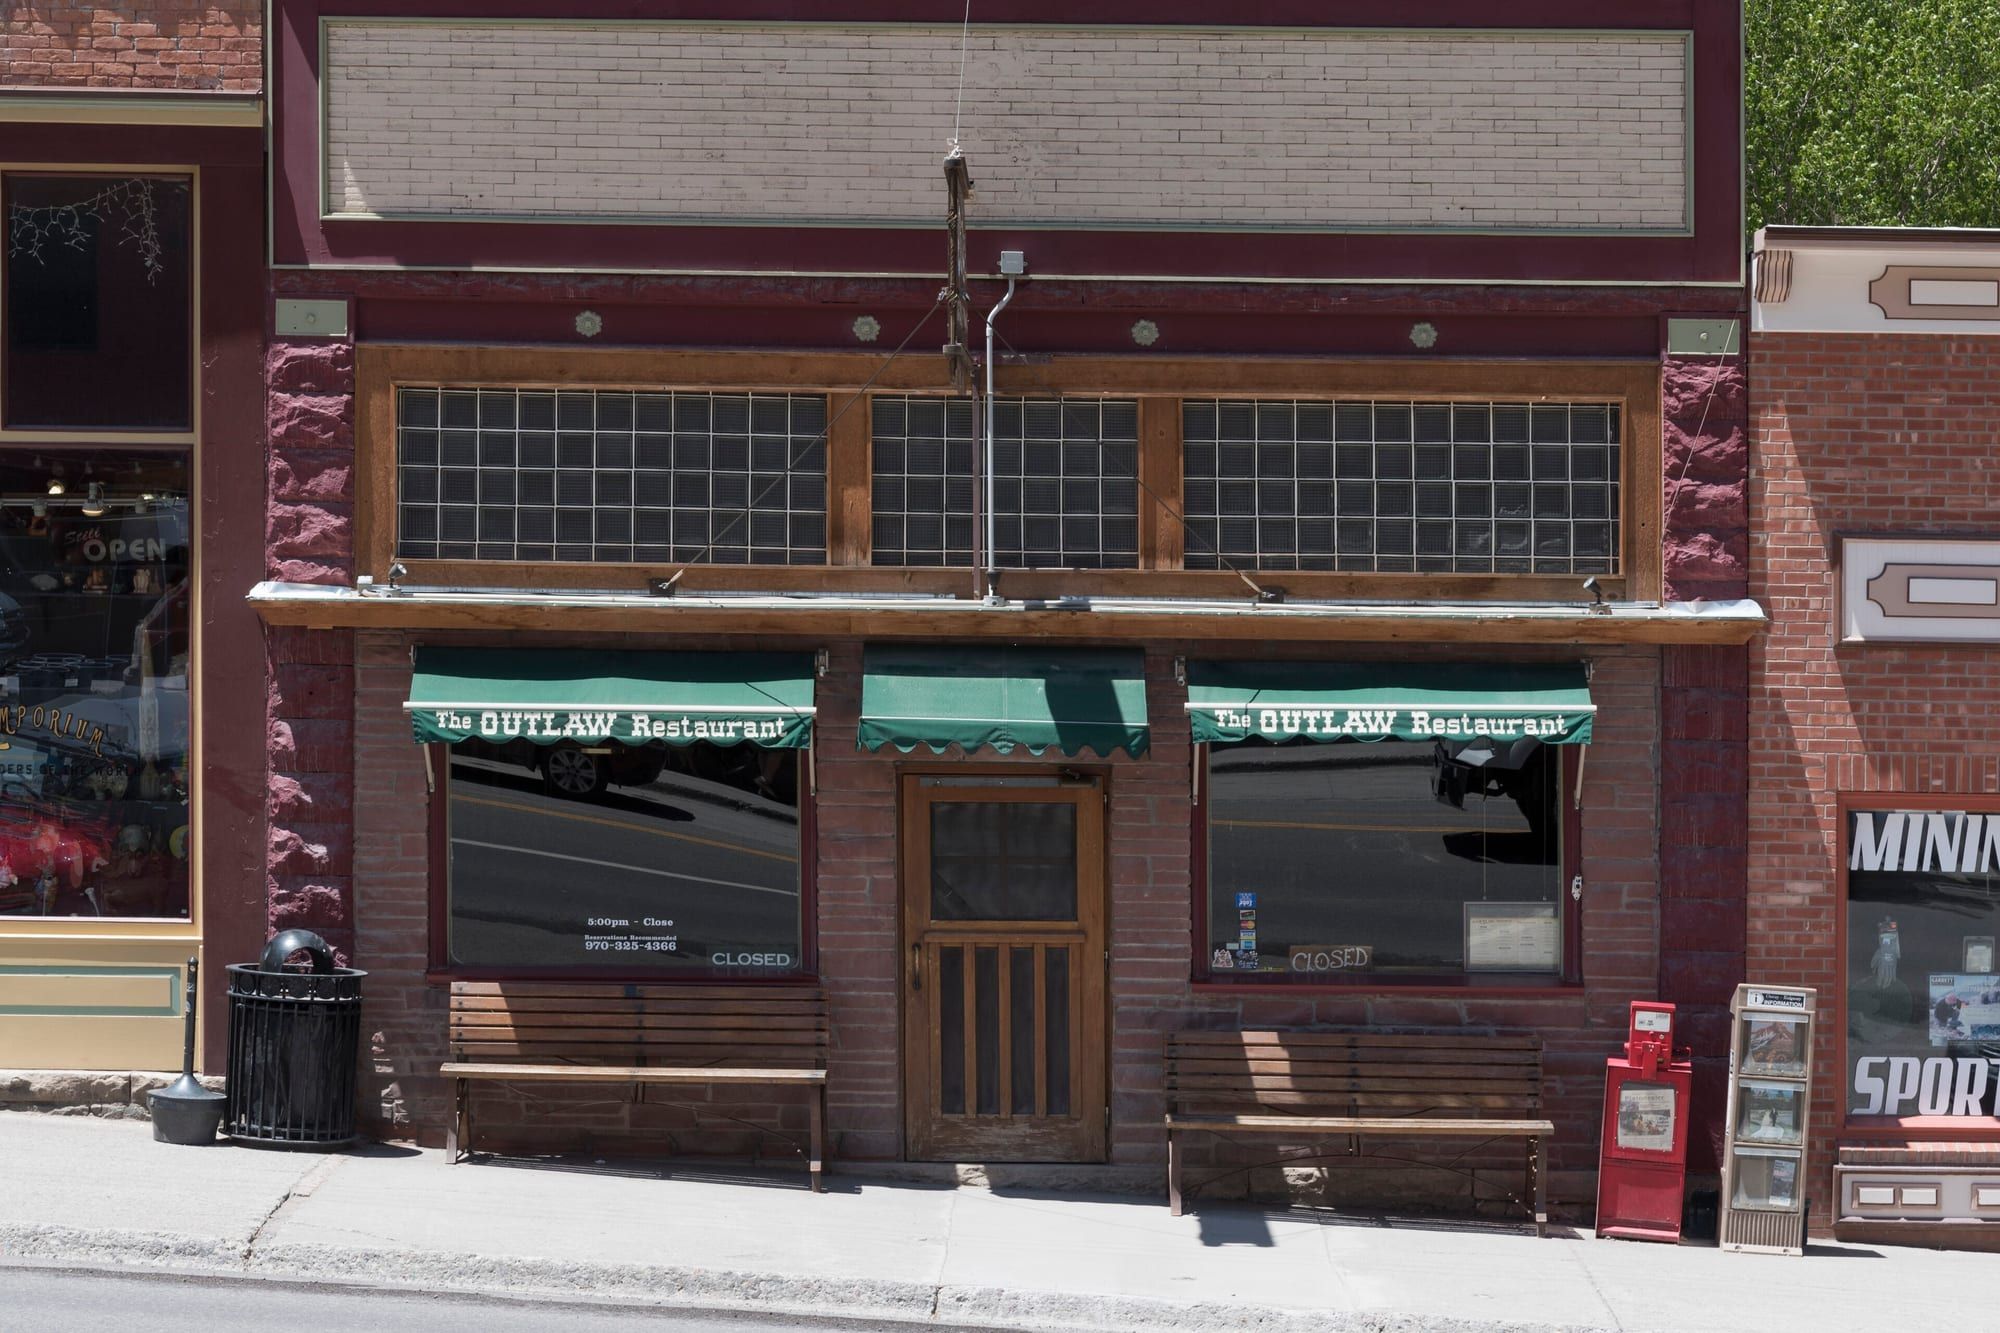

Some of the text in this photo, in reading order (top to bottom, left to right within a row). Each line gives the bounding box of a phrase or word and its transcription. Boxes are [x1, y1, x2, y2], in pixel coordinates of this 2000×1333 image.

[83, 538, 166, 561] OPEN
[436, 710, 787, 738] The OUTLAW Restaurant
[1215, 709, 1568, 736] The OUTLAW Restaurant
[587, 918, 629, 928] 5:00pm
[643, 917, 674, 926] Close
[585, 941, 677, 950] 970-325-4366
[711, 952, 791, 966] CLOSED
[1292, 947, 1369, 973] CLOSED
